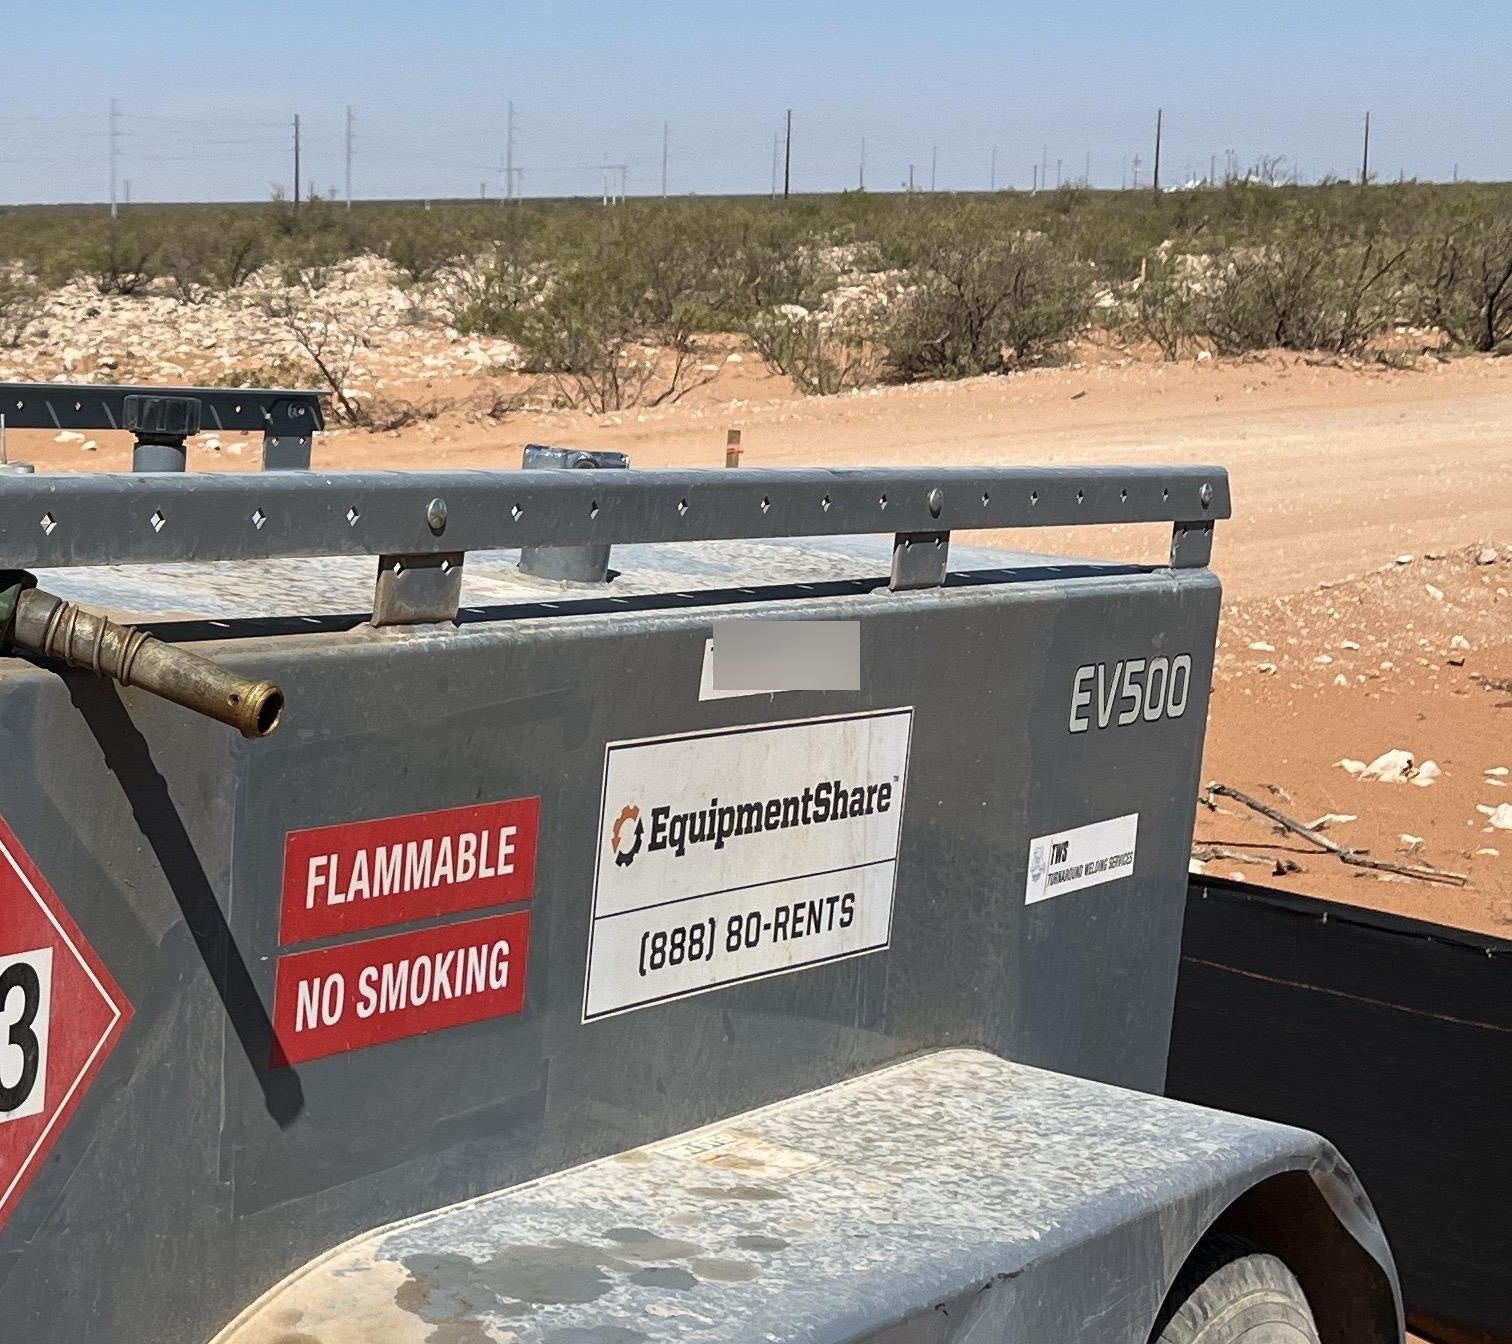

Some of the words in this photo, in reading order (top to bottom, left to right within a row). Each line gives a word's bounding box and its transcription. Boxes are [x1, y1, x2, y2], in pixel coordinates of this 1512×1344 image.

[1068, 652, 1193, 735] EV500
[647, 777, 894, 856] EquipmentShare
[1050, 841, 1069, 865] TWS
[304, 824, 518, 910] FLAMMABLE
[1108, 851, 1133, 869] SERVICES
[638, 920, 716, 977] (888)
[725, 892, 857, 953] 80-RENTS
[295, 973, 345, 1034] NO
[357, 939, 510, 1020] SMOKING
